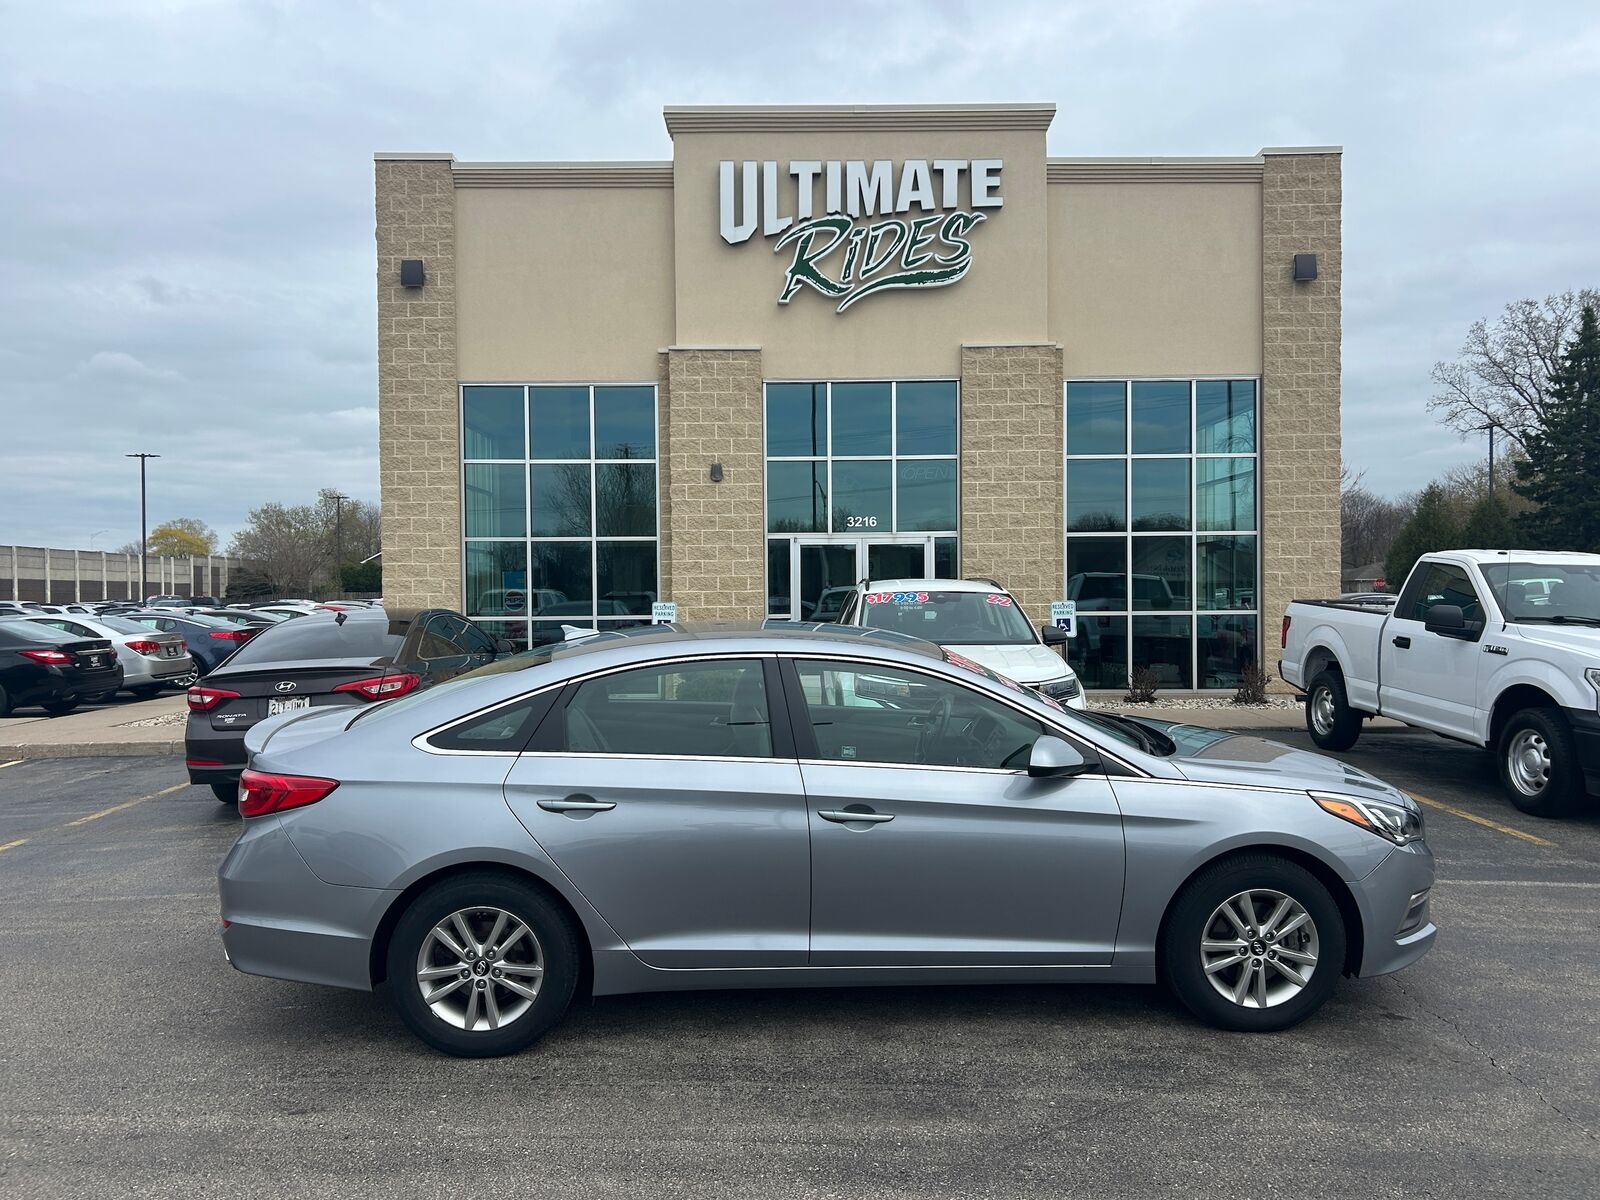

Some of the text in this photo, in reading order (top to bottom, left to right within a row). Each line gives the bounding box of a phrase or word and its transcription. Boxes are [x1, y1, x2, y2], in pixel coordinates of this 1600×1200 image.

[719, 159, 1004, 245] ULTIMATE
[846, 515, 878, 527] 3216
[865, 592, 929, 605] $17995
[986, 593, 1012, 607] 22
